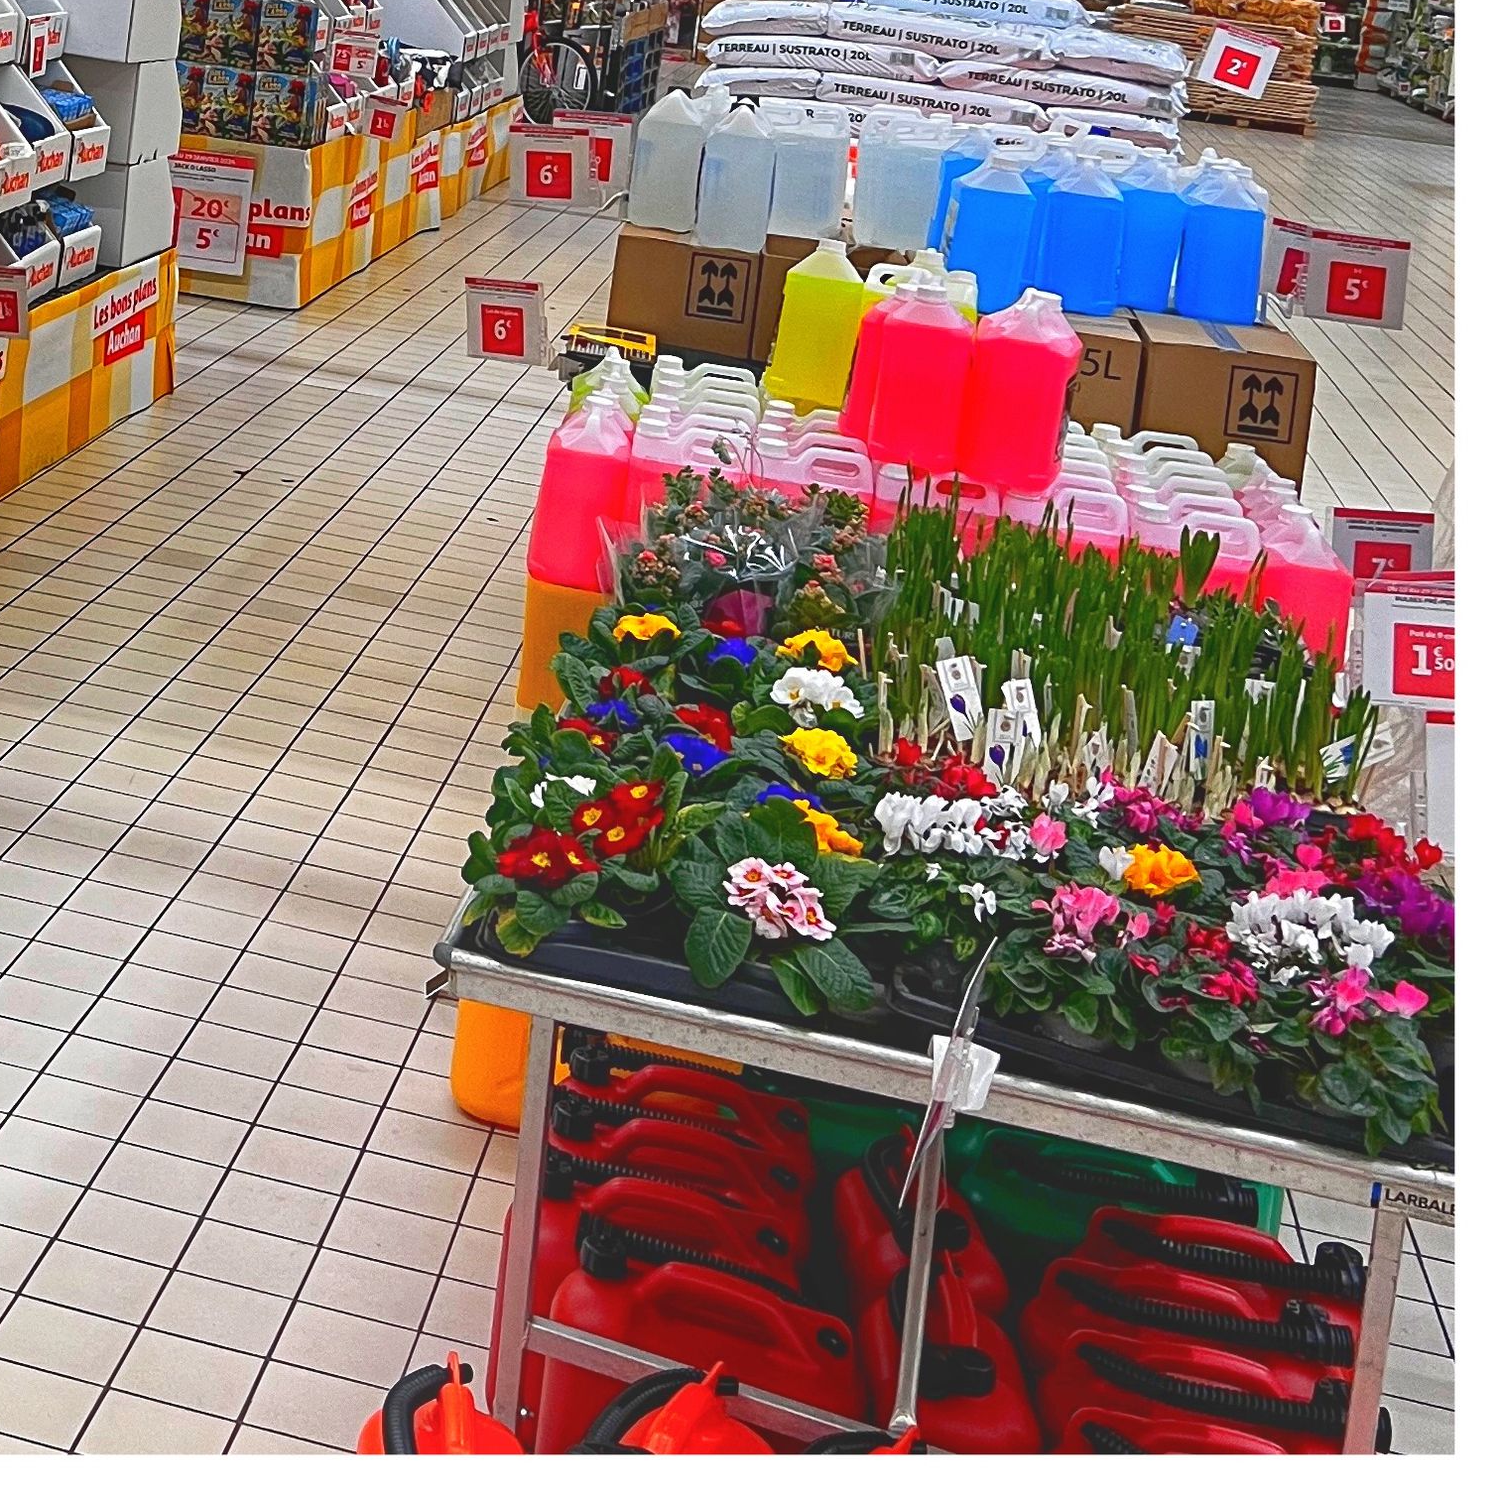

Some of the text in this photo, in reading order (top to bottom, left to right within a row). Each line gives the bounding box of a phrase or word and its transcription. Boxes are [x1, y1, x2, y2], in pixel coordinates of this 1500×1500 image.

[842, 20, 896, 37] TERREAU
[905, 31, 968, 50] SUSTRATO
[717, 43, 770, 53] TERREAU
[779, 44, 841, 58] SUSTRATO
[834, 83, 888, 101] TERREAU
[897, 94, 960, 112] SUSTRATO
[967, 71, 1023, 88] TERREAU
[1031, 80, 1095, 98] SUSTRATO
[250, 198, 310, 221] plans
[94, 277, 157, 330] Les bons plans
[106, 323, 141, 356] Auchan
[1080, 347, 1122, 381] 5L
